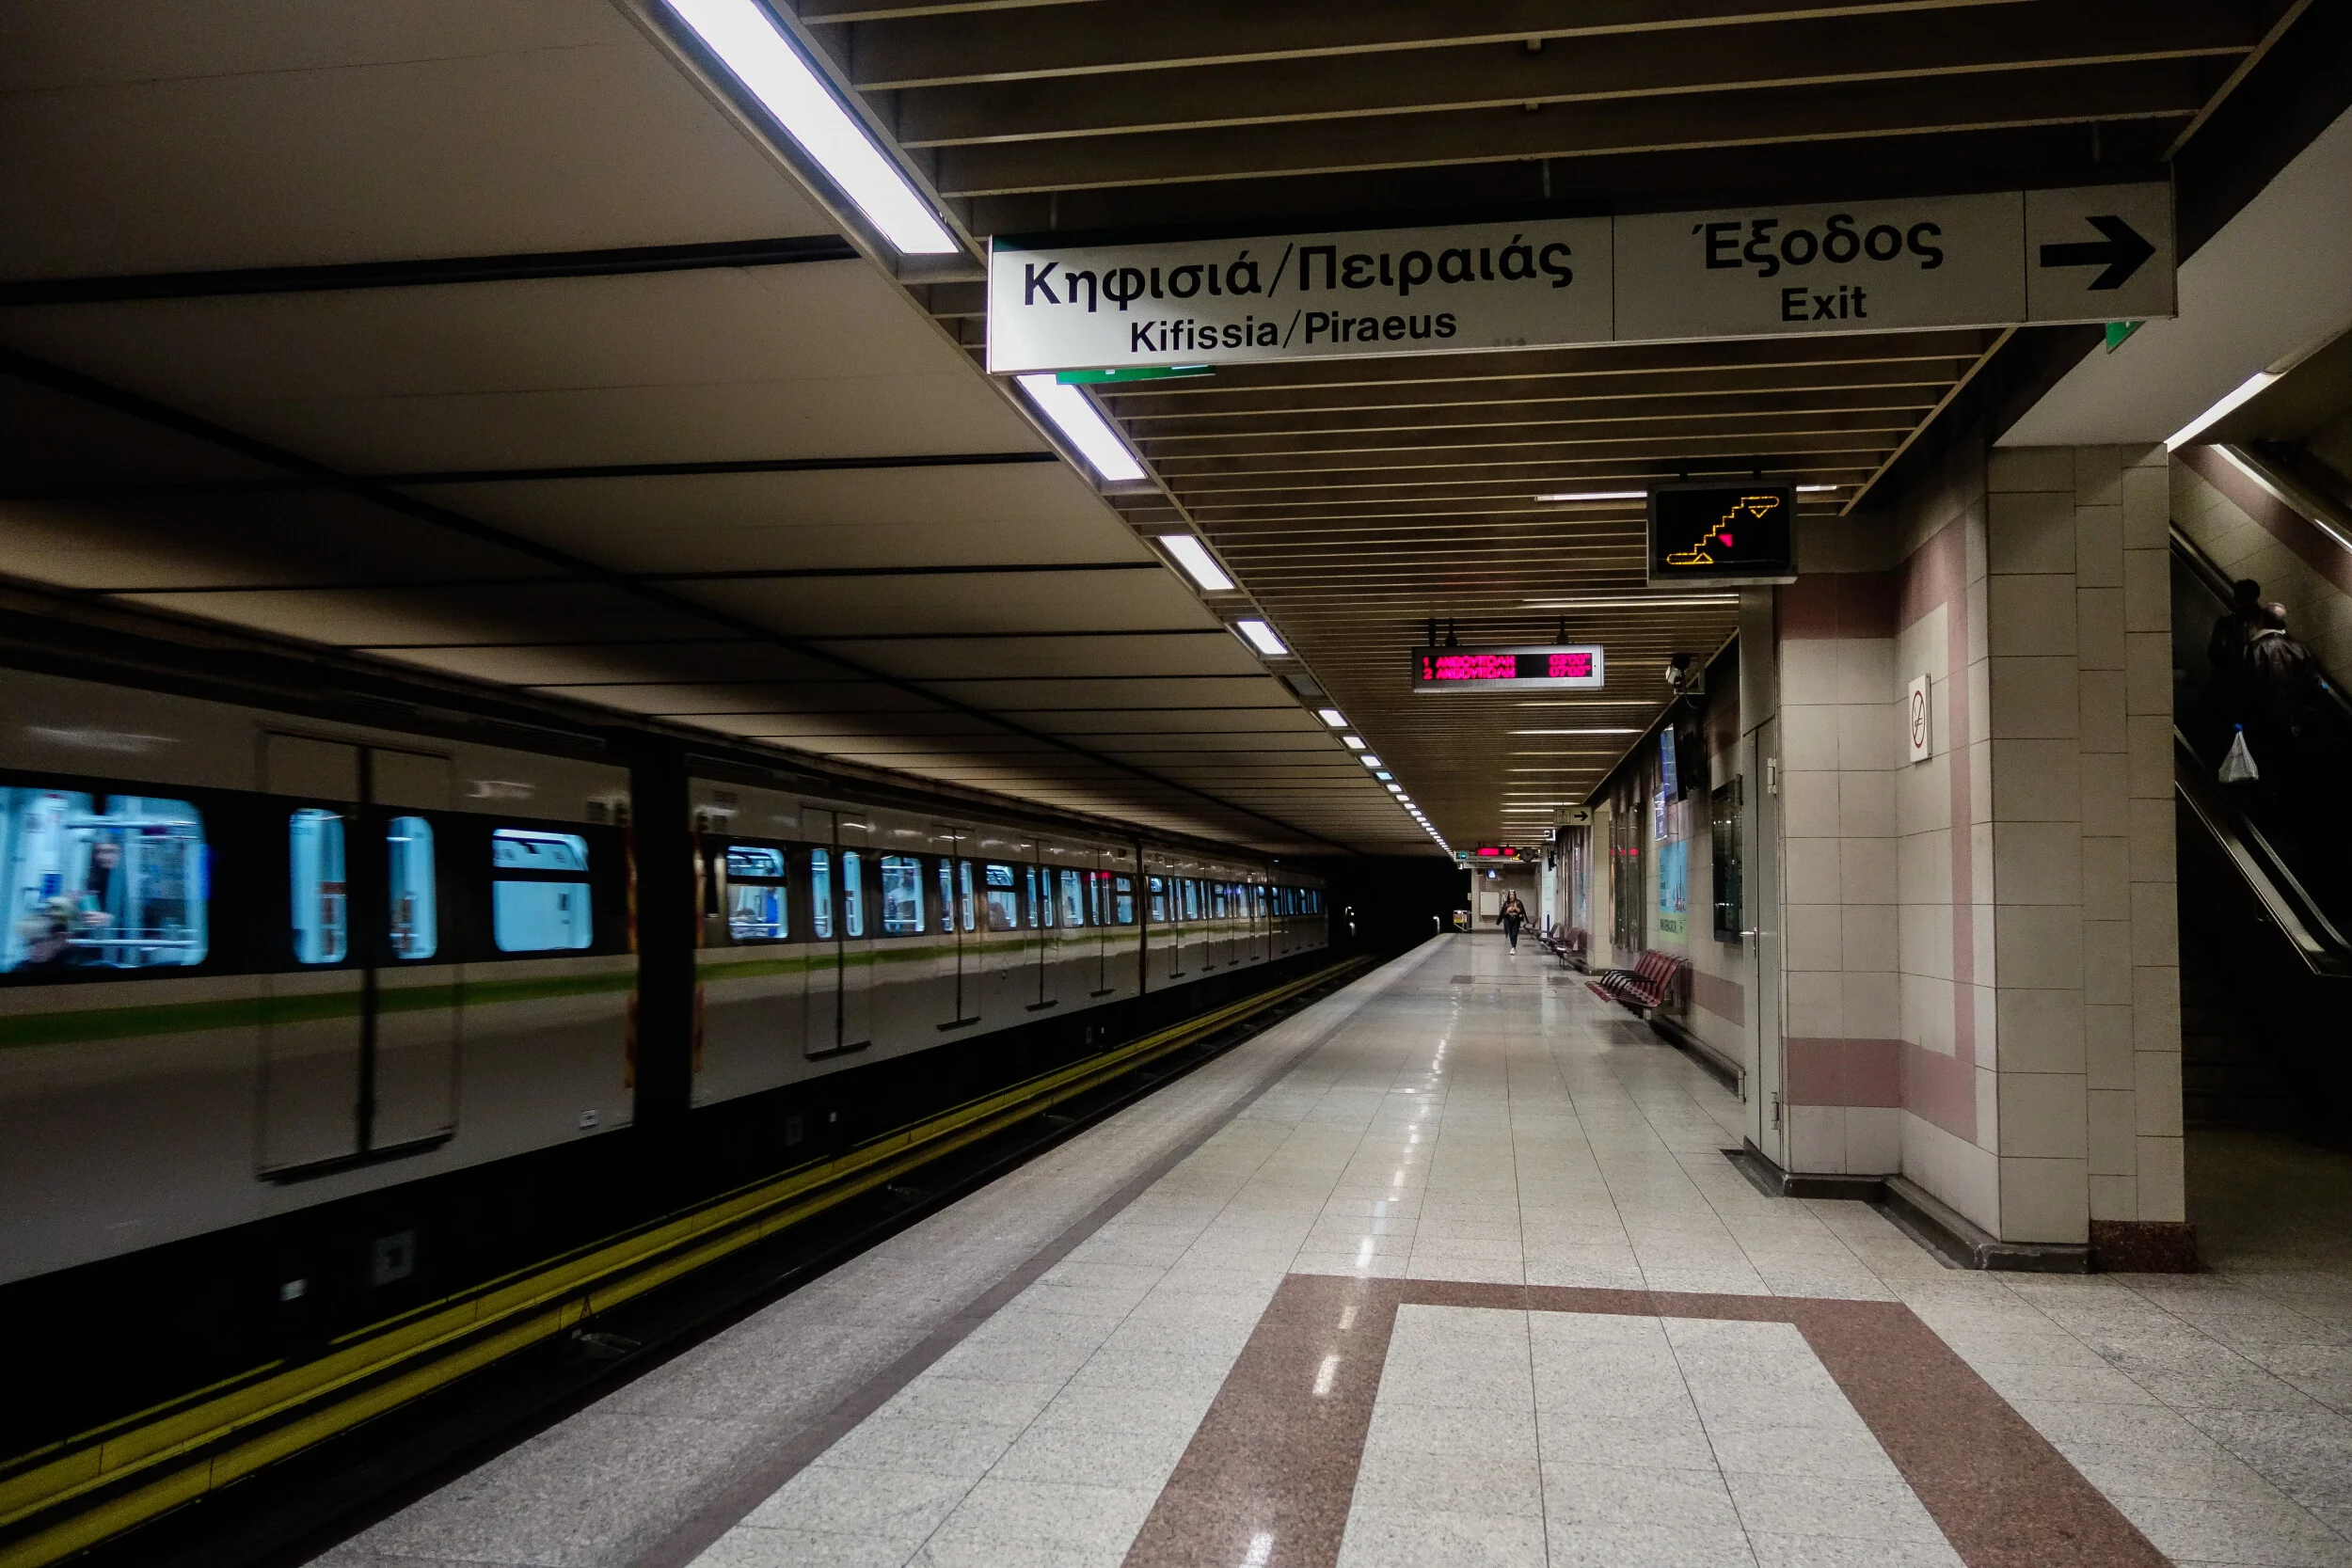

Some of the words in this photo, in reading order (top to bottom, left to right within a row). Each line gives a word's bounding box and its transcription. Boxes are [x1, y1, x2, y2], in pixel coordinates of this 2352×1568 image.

[1692, 214, 1944, 277] Έξοδος
[1781, 285, 1867, 322] Exit
[1131, 310, 1456, 353] Kifissia/Piraeus
[1422, 668, 1433, 679] 2
